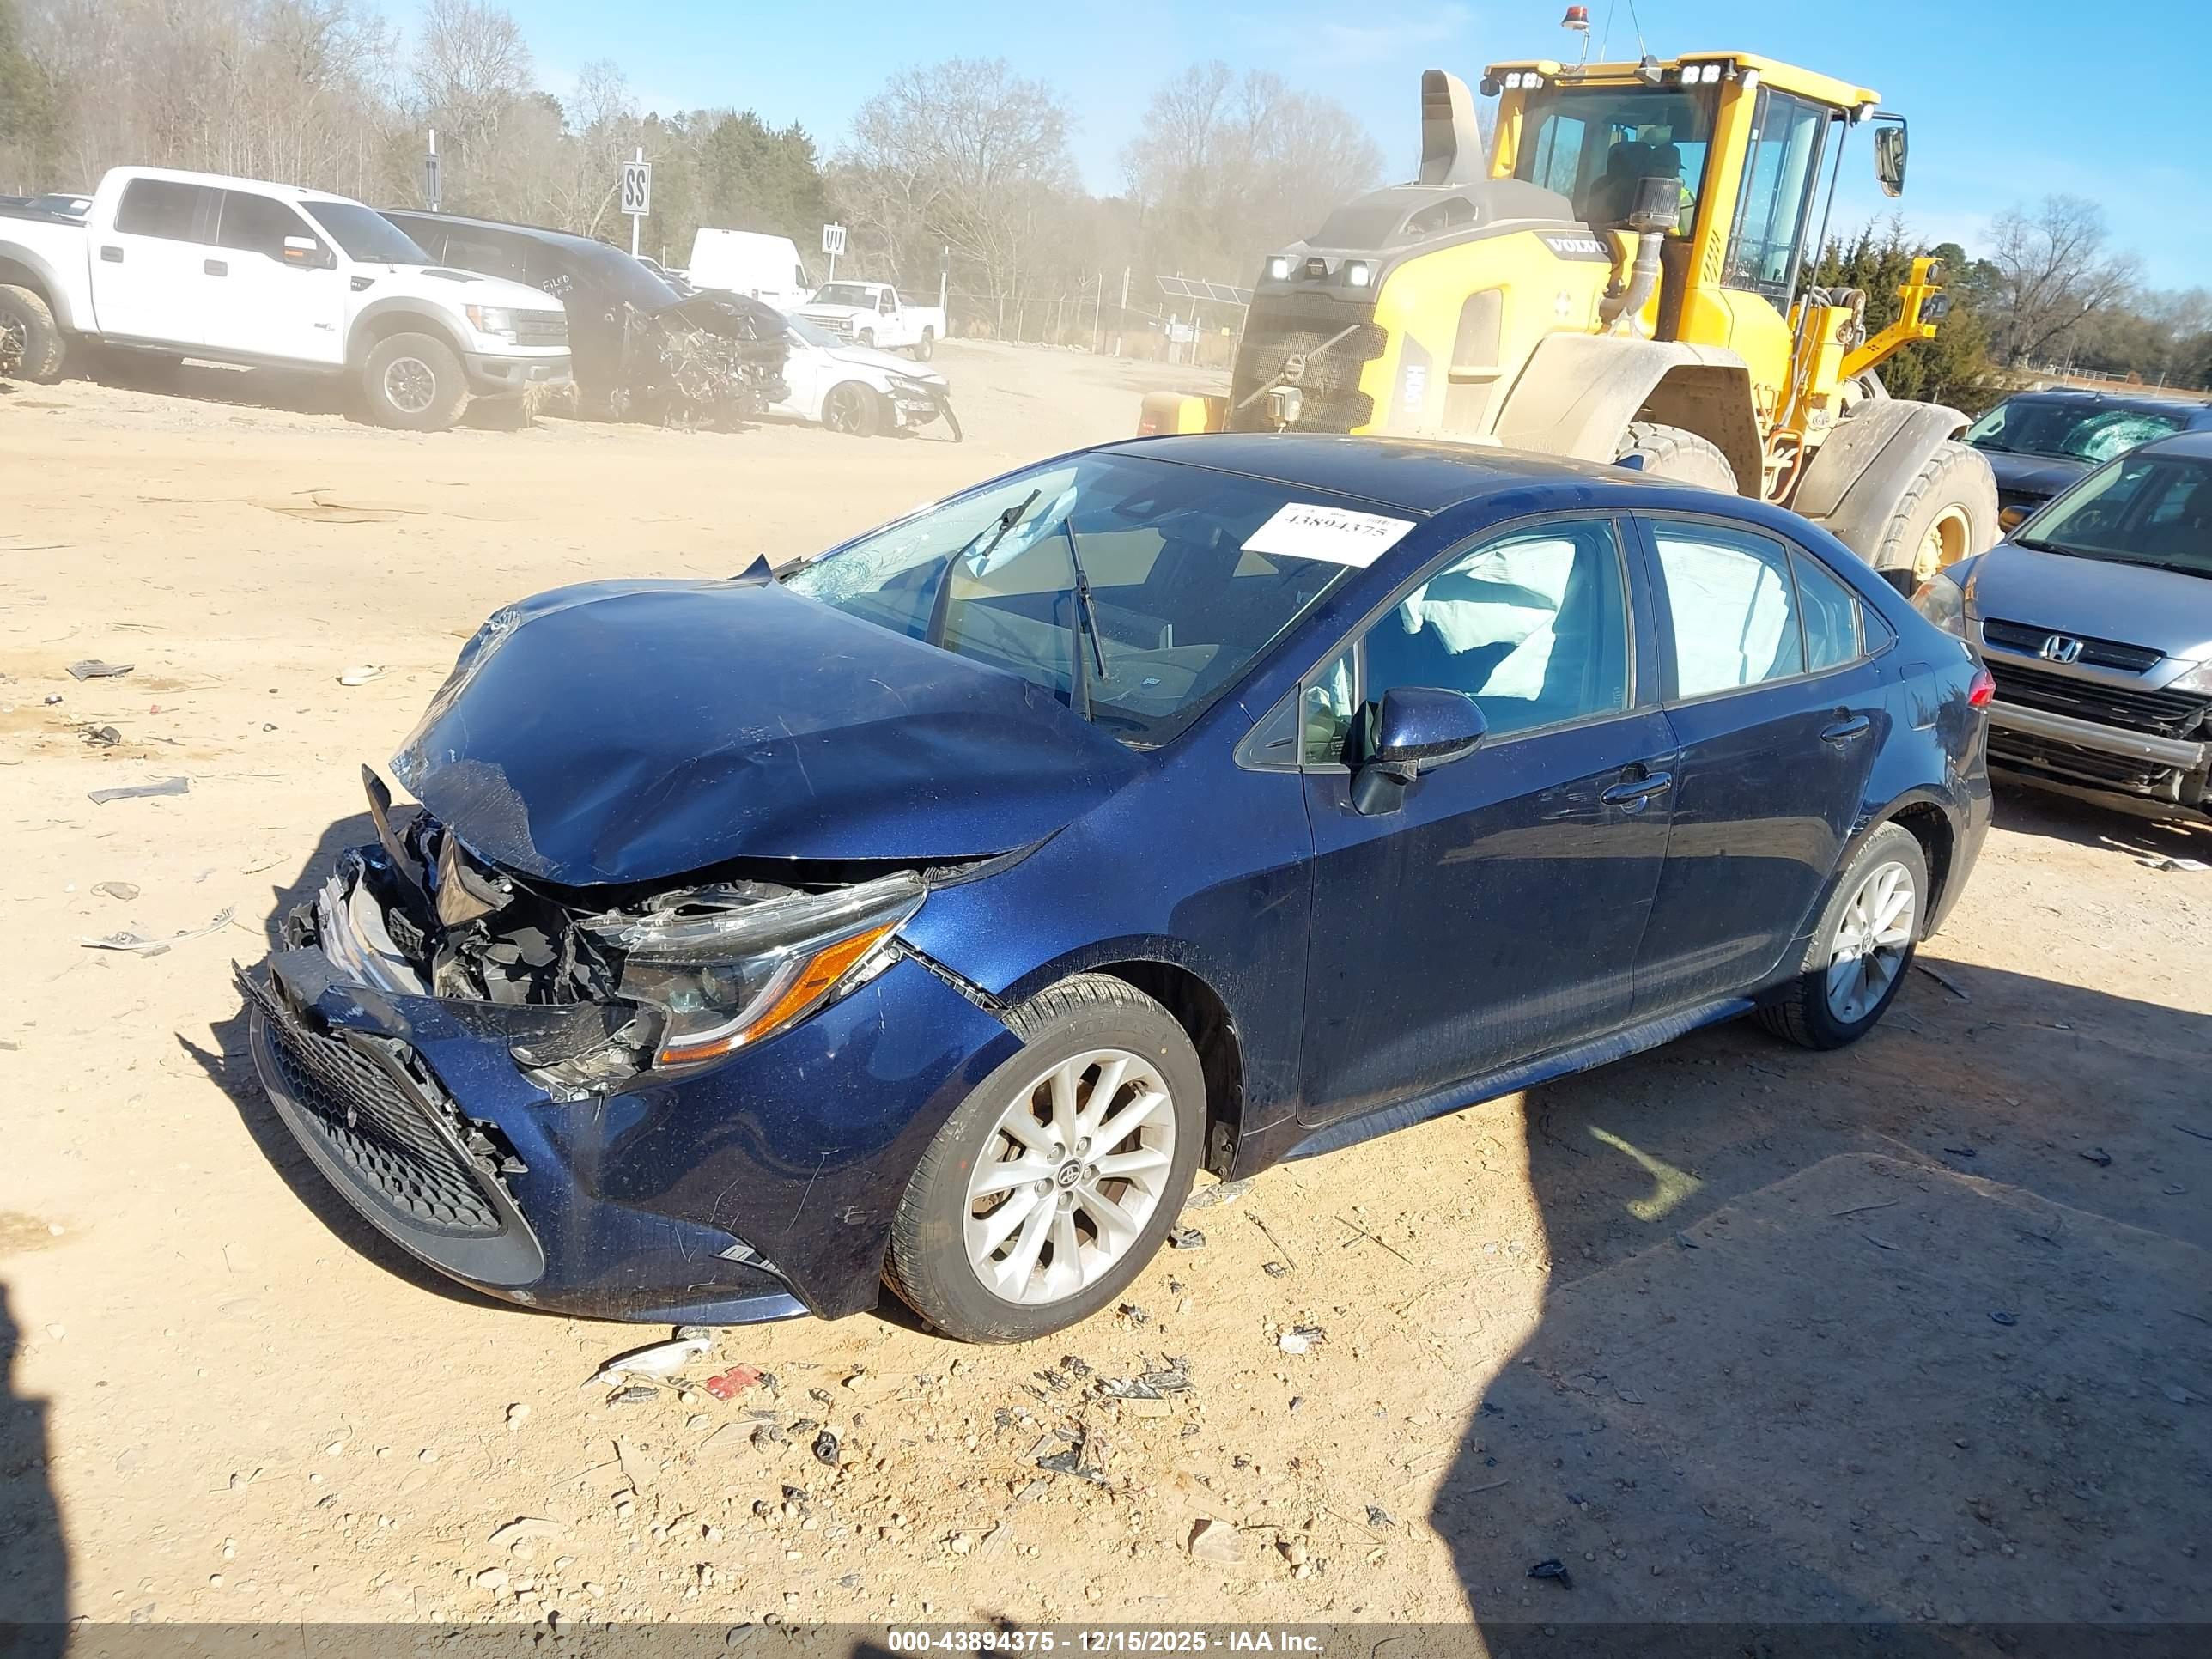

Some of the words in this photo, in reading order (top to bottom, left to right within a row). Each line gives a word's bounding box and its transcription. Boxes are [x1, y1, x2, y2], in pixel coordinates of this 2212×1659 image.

[625, 168, 646, 207] SS
[1545, 238, 1609, 252] VOLVO
[1285, 514, 1389, 537] 43894375
